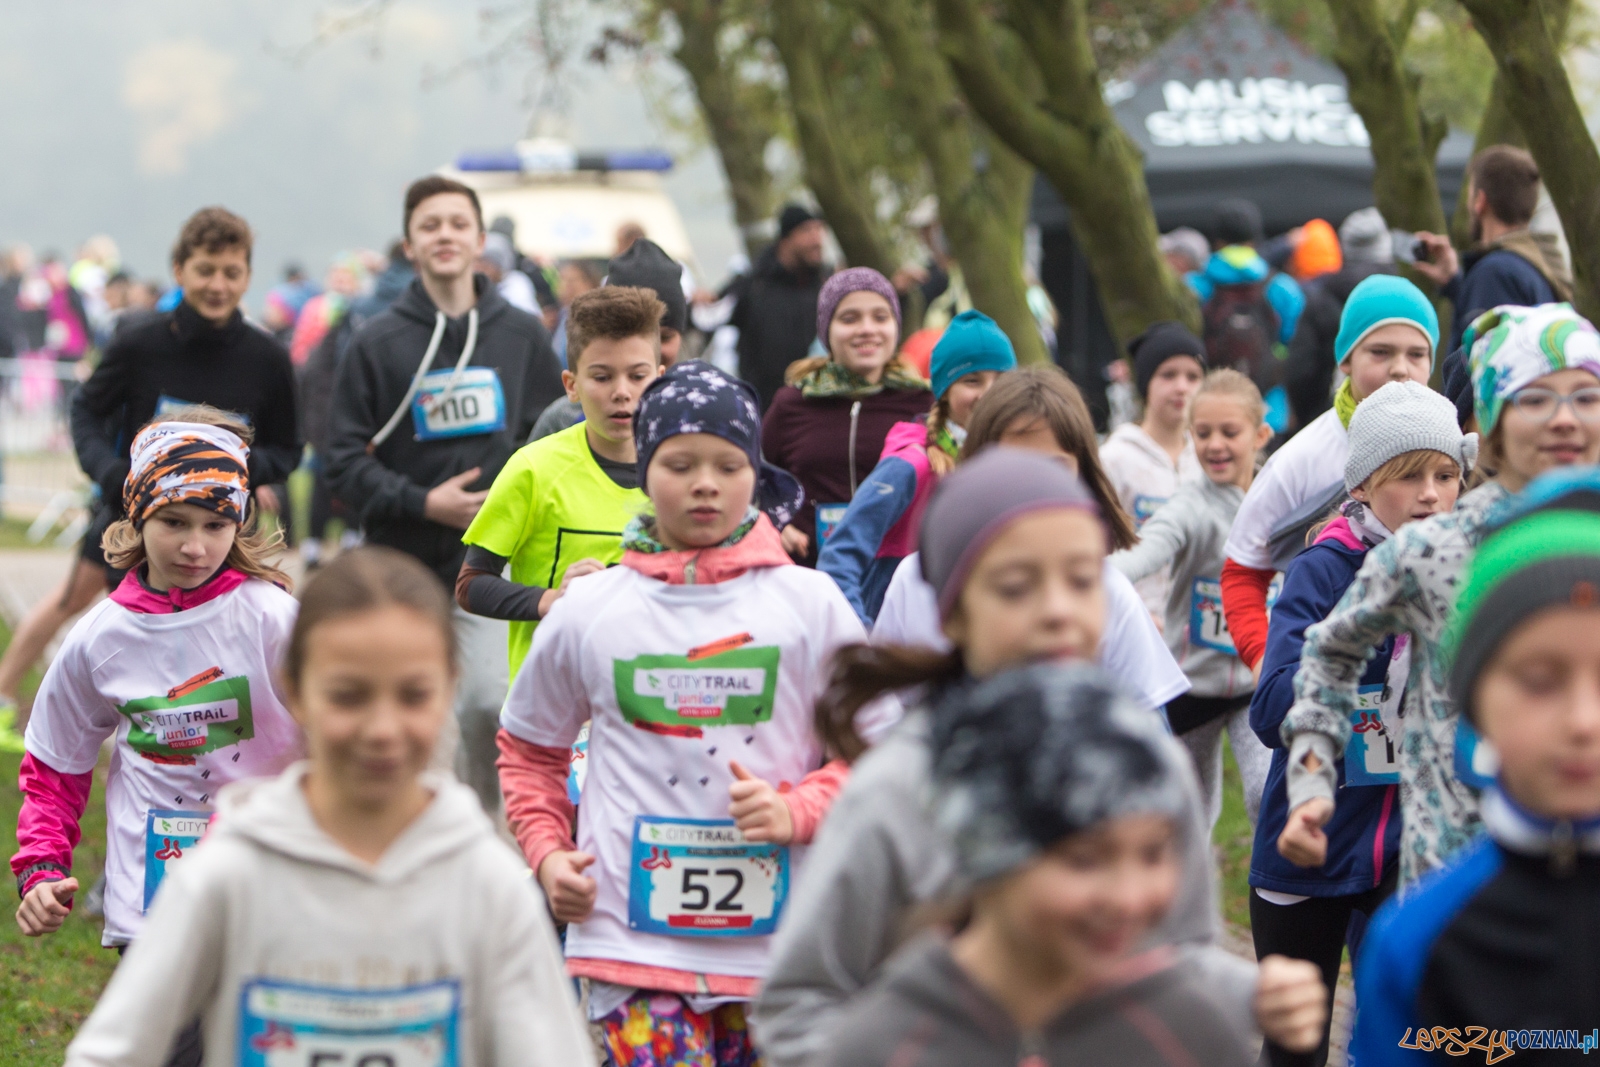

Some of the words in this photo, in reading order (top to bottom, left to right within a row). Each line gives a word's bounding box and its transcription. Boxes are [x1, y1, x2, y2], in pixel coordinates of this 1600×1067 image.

[1162, 77, 1349, 112] MUSIC
[162, 726, 202, 740] Junior
[680, 868, 744, 911] 52
